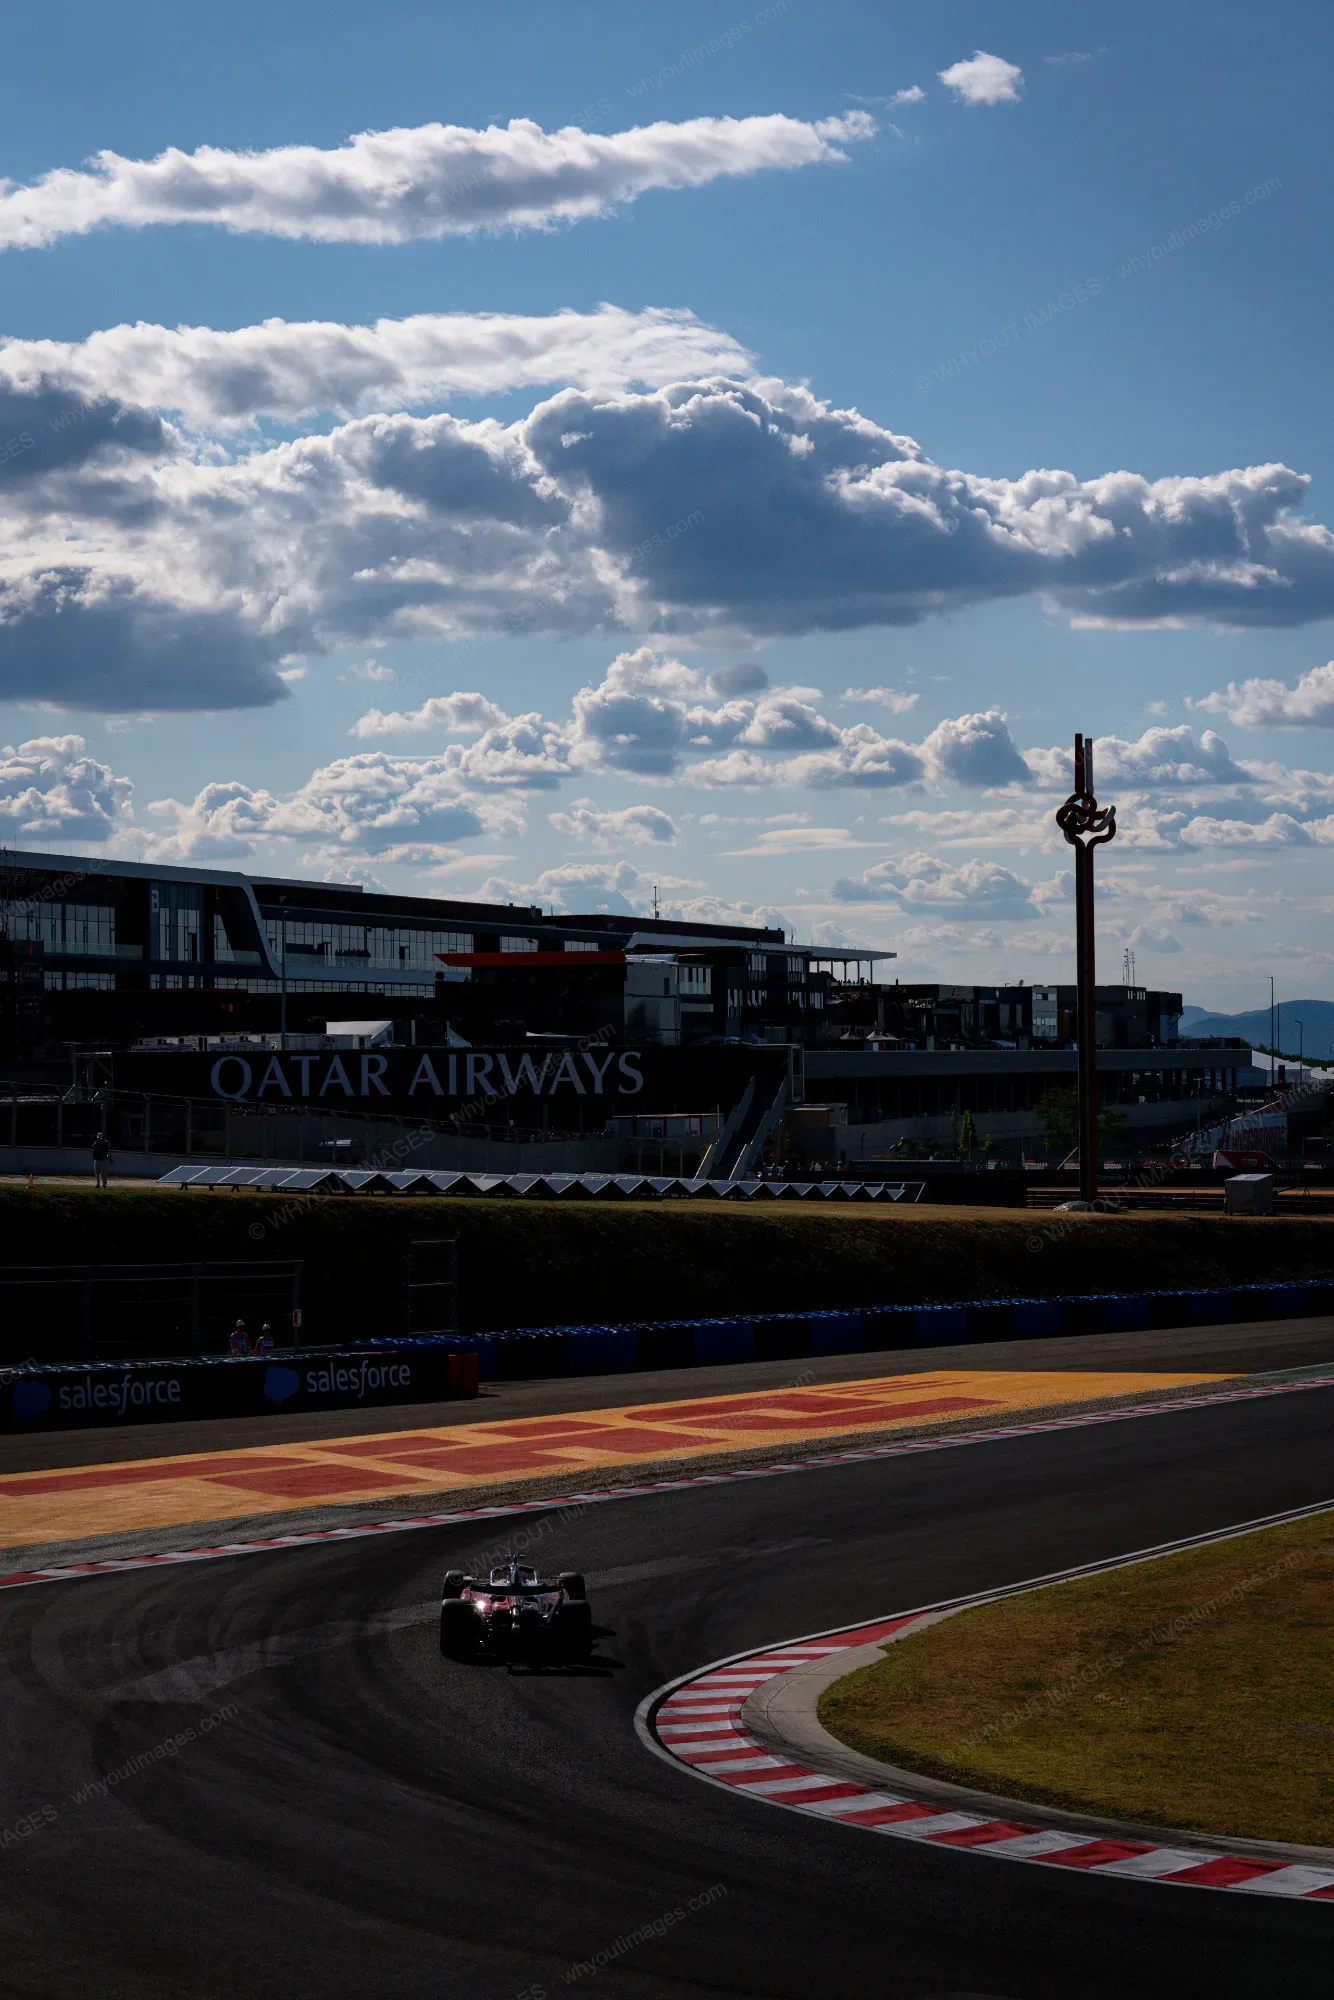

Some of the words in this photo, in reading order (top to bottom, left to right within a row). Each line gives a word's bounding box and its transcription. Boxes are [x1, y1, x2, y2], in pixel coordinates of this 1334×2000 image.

[211, 1054, 391, 1102] QATAR
[408, 1051, 644, 1096] AIRWAYS
[59, 1374, 181, 1417] salesforce
[306, 1359, 411, 1398] salesforce
